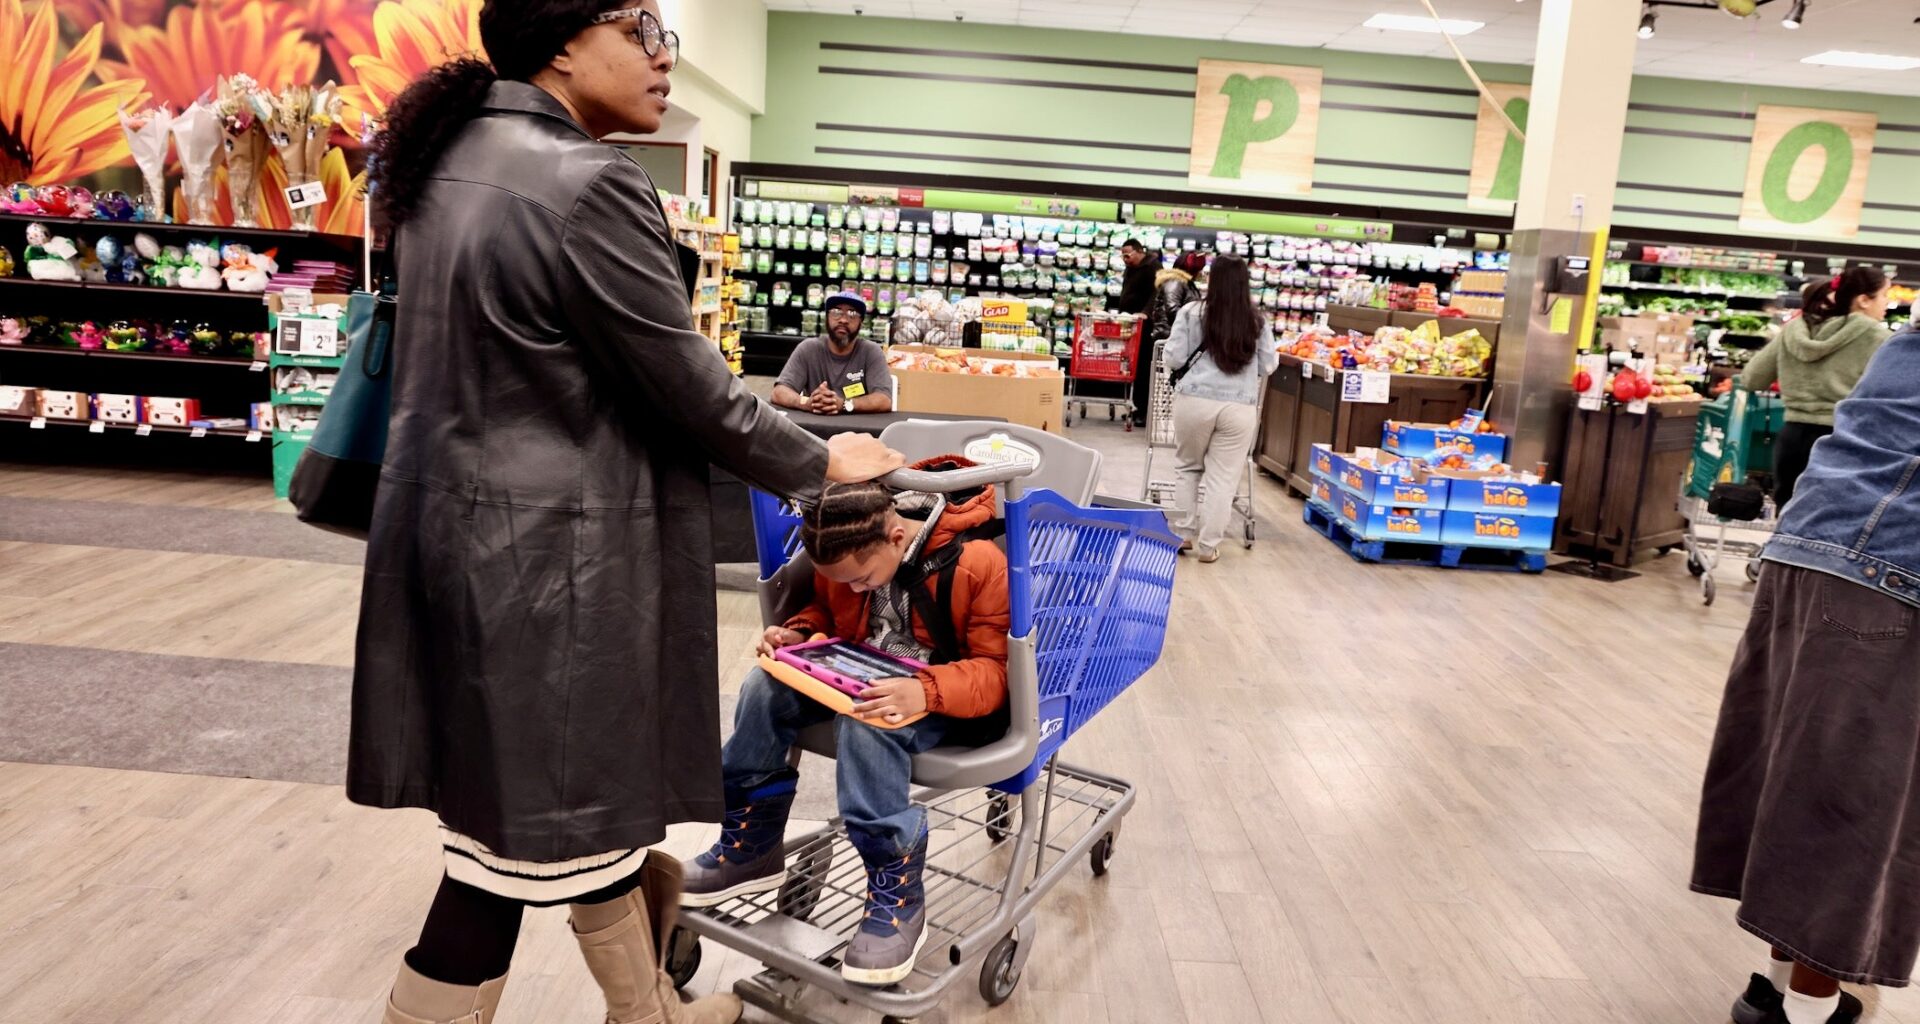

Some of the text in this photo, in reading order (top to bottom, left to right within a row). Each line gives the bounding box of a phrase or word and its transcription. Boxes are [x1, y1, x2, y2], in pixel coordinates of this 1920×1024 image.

[983, 306, 1008, 317] GLAD
[1394, 489, 1429, 504] halos
[1483, 488, 1528, 508] halos
[1387, 518, 1421, 533] halos
[1475, 518, 1520, 539] halos
